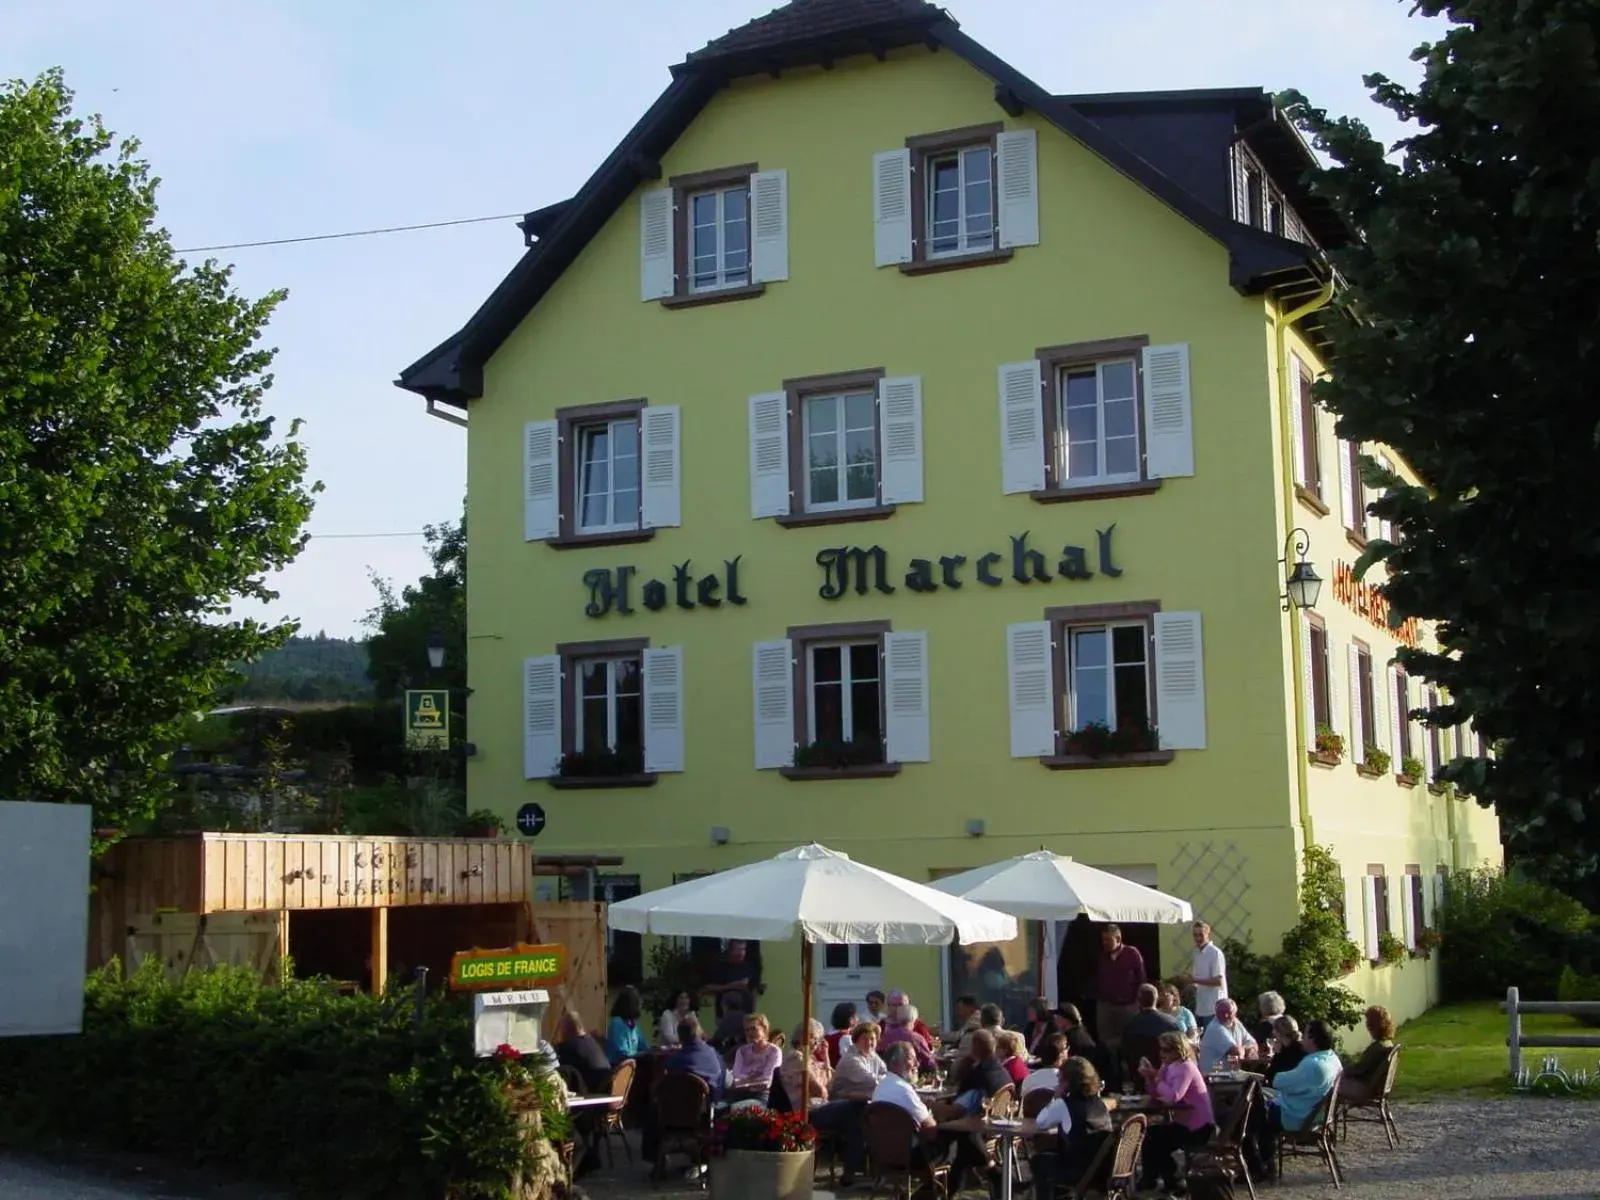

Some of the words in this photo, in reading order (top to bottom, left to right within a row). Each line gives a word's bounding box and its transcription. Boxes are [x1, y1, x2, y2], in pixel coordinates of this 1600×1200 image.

[583, 555, 748, 618] Hotel
[816, 522, 1123, 600] Marchal
[461, 962, 495, 979] LOGIS
[497, 960, 512, 976] DE
[514, 957, 557, 975] FRANCE
